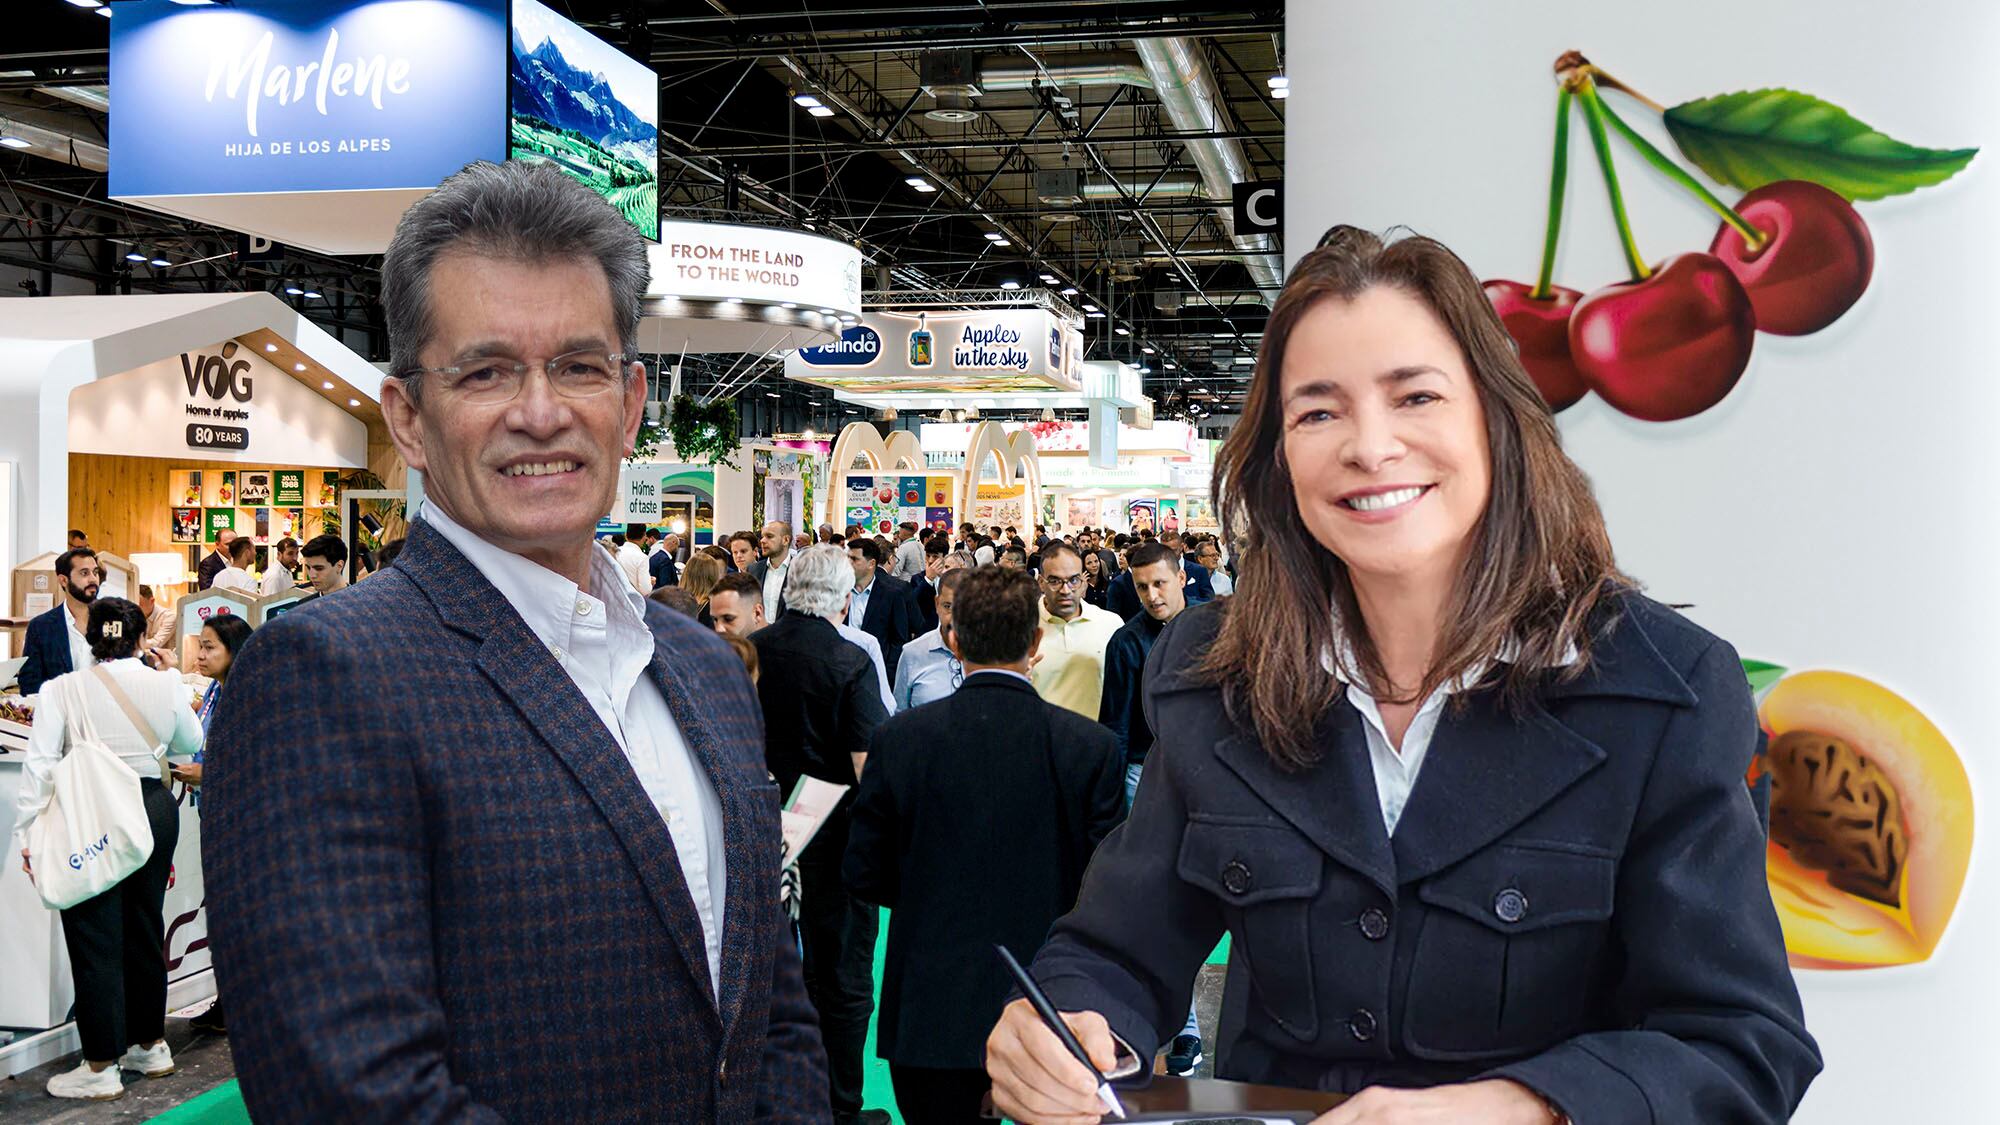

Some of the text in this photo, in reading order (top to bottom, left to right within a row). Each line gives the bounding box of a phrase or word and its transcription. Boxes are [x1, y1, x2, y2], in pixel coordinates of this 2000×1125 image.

[205, 27, 410, 136] Marlene
[225, 138, 391, 156] HIJA DE LOS ALPES
[1246, 188, 1277, 226] C
[671, 244, 804, 268] FROM THE LAND
[677, 264, 800, 287] TO THE WORLD
[802, 333, 876, 354] elinda
[962, 323, 1021, 347] Apples
[955, 347, 972, 366] in
[972, 346, 997, 366] the
[998, 347, 1029, 370] sky
[186, 404, 249, 421] Home of apples
[195, 427, 242, 444] 80 YEARS
[631, 480, 655, 496] Home
[629, 498, 657, 513] of taste
